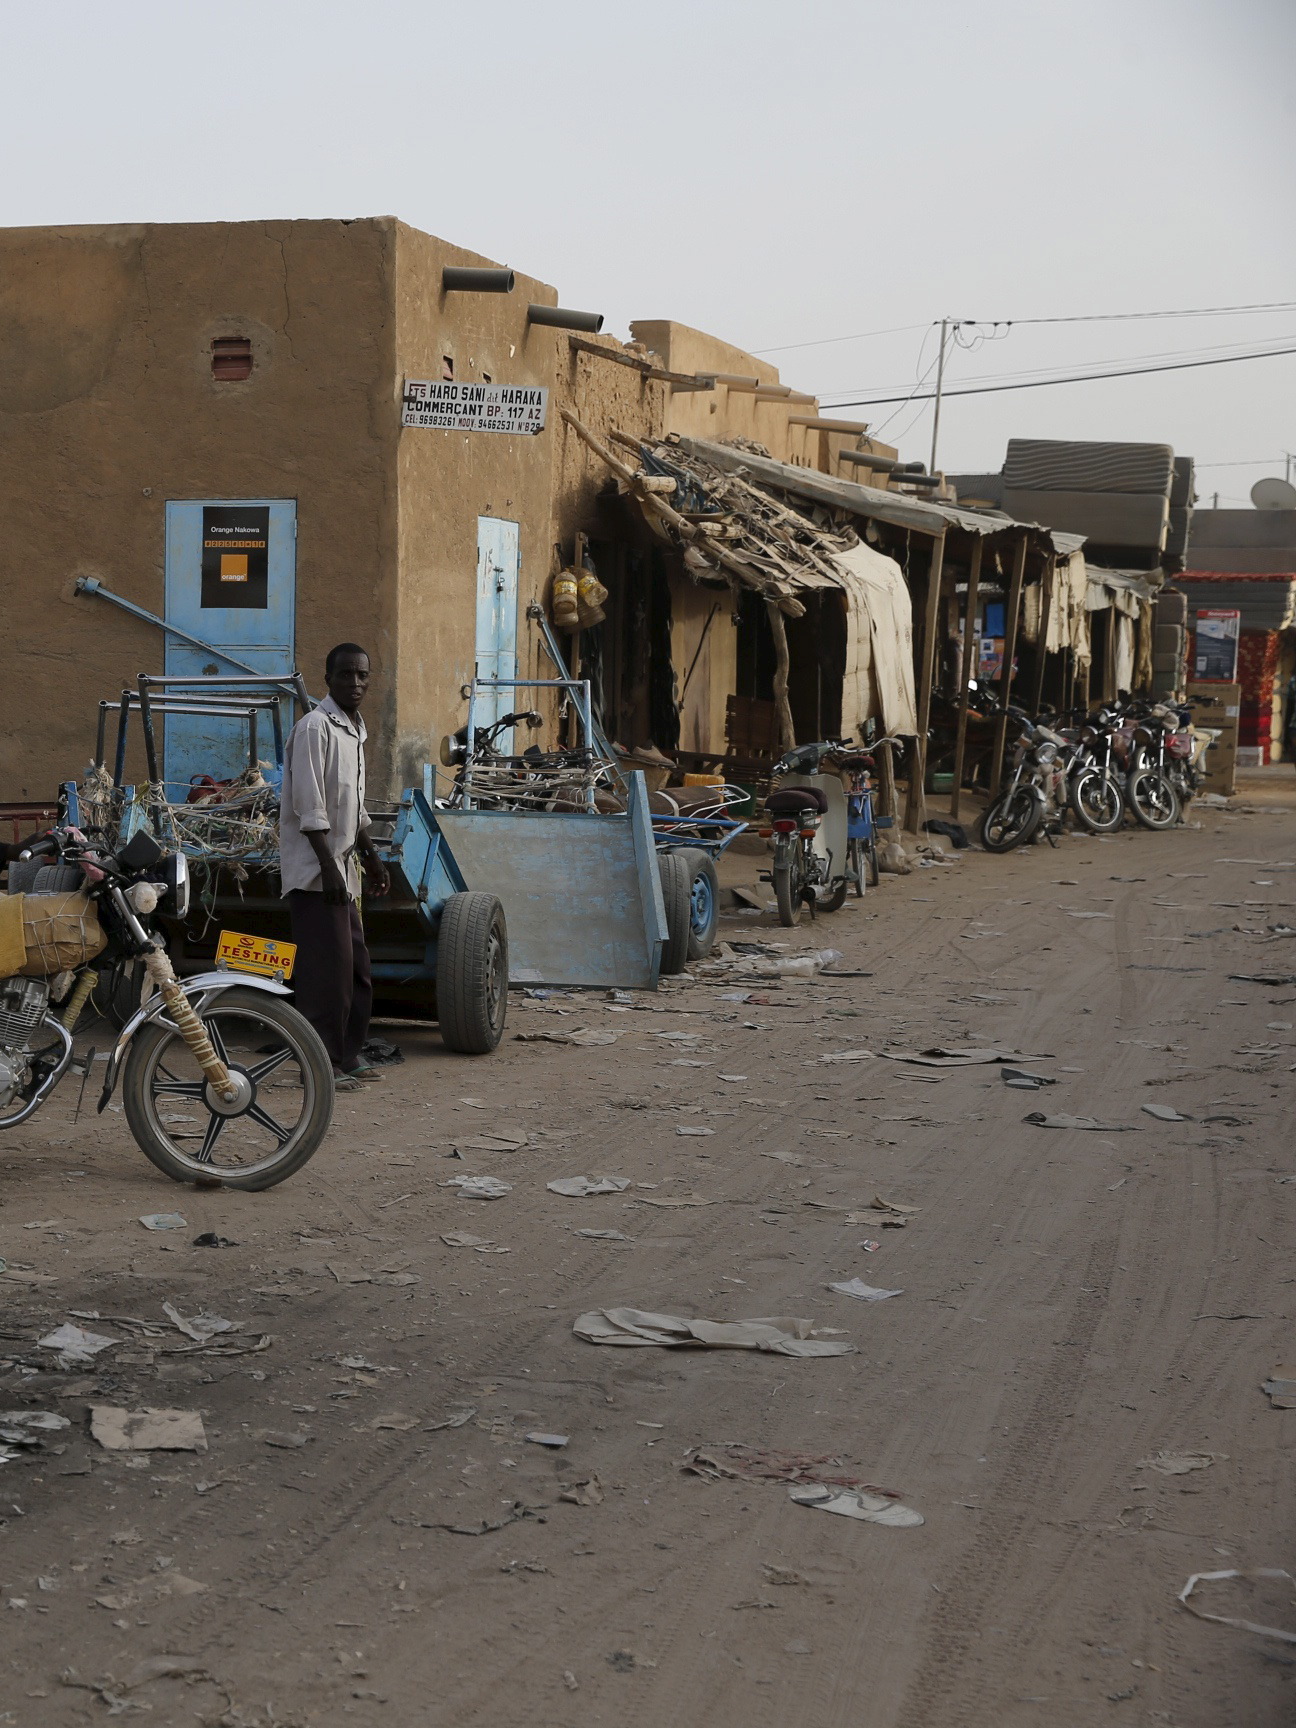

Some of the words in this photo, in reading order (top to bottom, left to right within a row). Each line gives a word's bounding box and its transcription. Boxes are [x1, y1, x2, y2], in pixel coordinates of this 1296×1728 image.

[409, 384, 426, 398] ETS
[429, 384, 458, 400] HARO
[461, 386, 486, 402] SANI
[486, 391, 499, 404] dit
[501, 389, 542, 406] HARAKA
[508, 407, 524, 418] 117
[528, 408, 542, 420] AZ
[418, 414, 456, 427] 96983261
[478, 418, 515, 430] 94662531
[210, 526, 234, 534] Orange
[222, 946, 290, 966] TESTING
